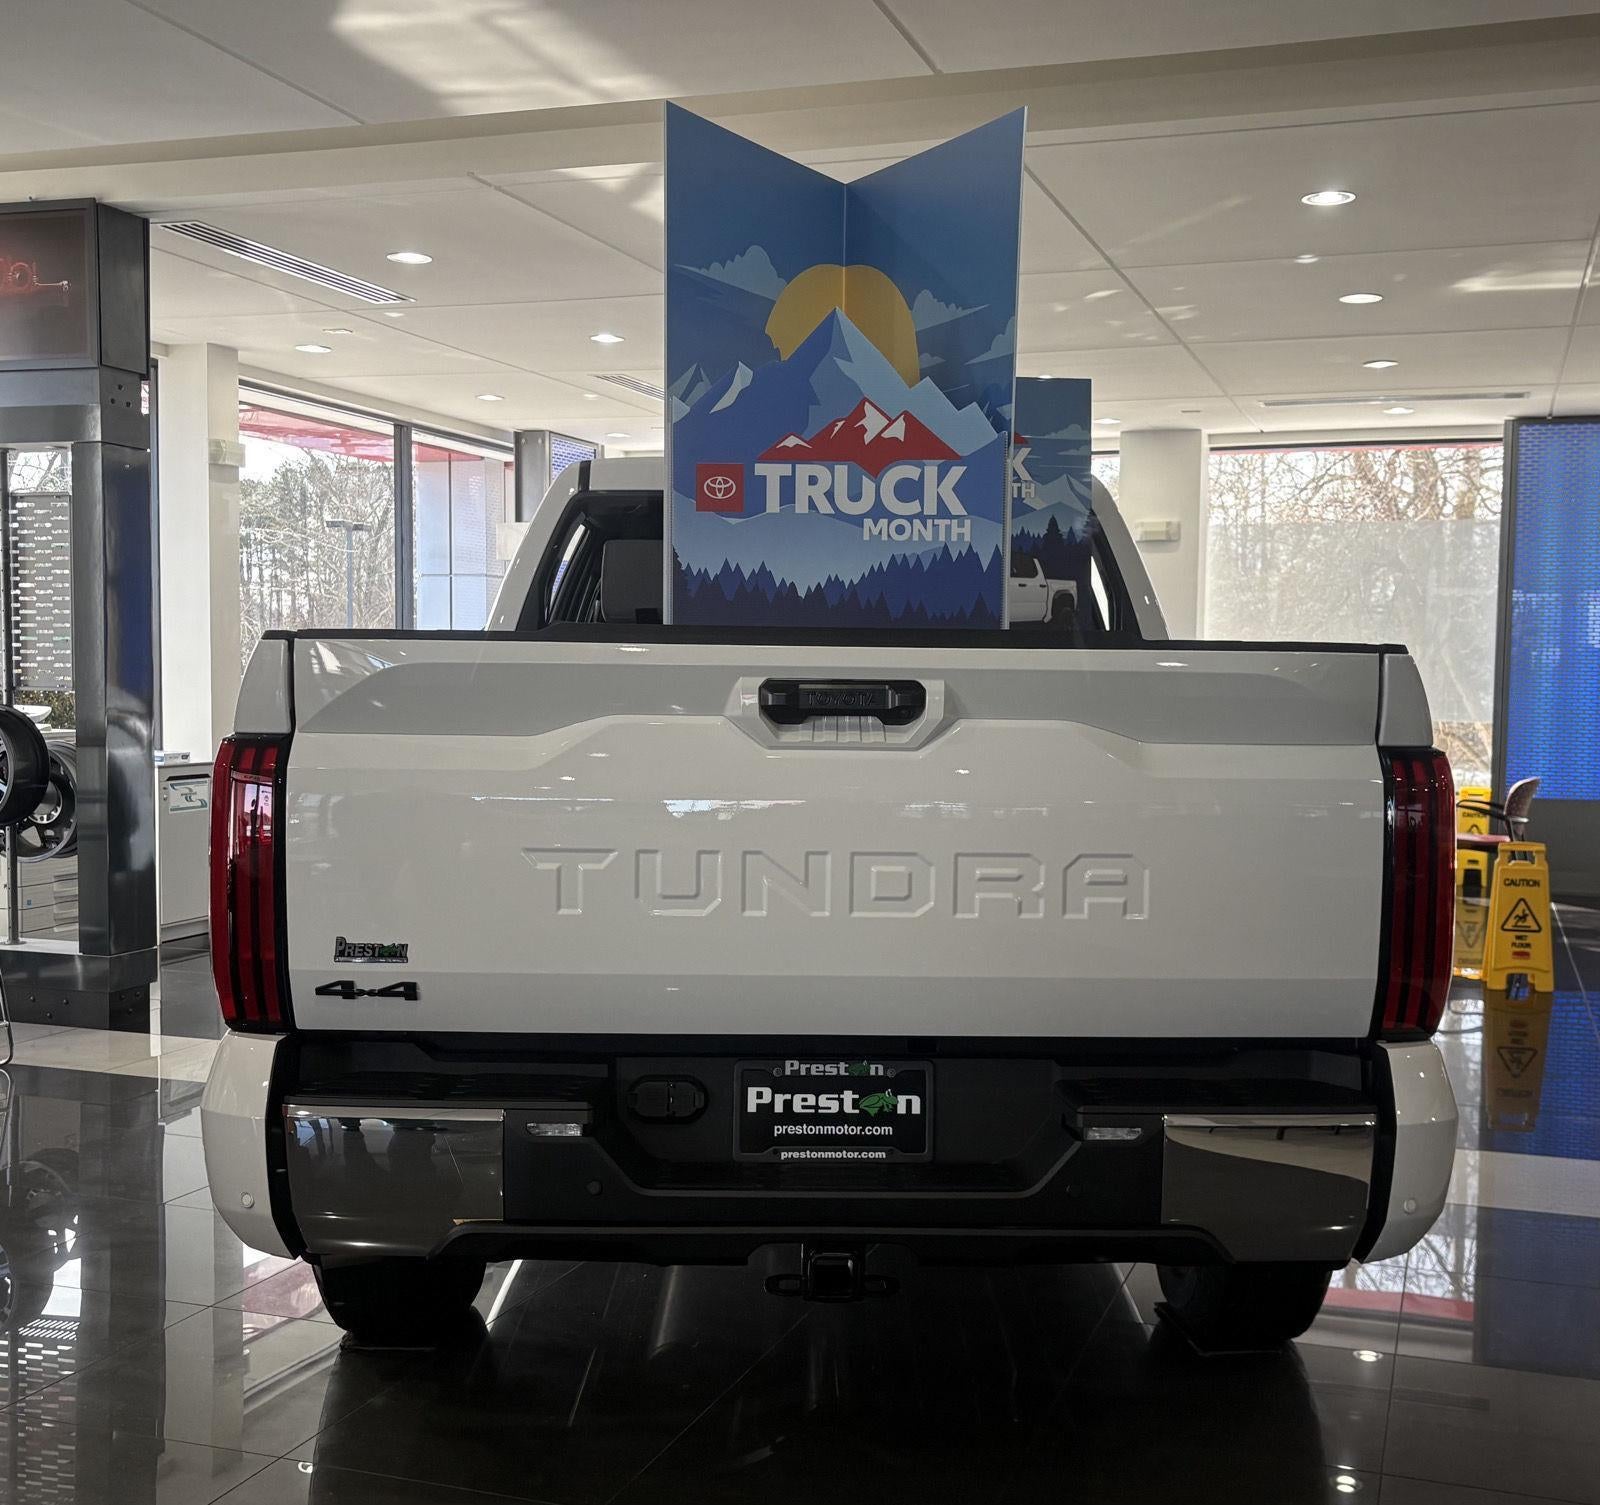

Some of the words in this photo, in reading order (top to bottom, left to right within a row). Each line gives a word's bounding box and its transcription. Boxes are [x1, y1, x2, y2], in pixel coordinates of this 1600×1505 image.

[753, 462, 968, 516] TRUCK
[863, 518, 971, 541] MONTH
[520, 847, 1151, 920] TUNDRA
[1503, 878, 1541, 888] CAUTION
[773, 1123, 893, 1136] prestonmotor.com
[780, 1149, 886, 1159] prestonmotor.com
